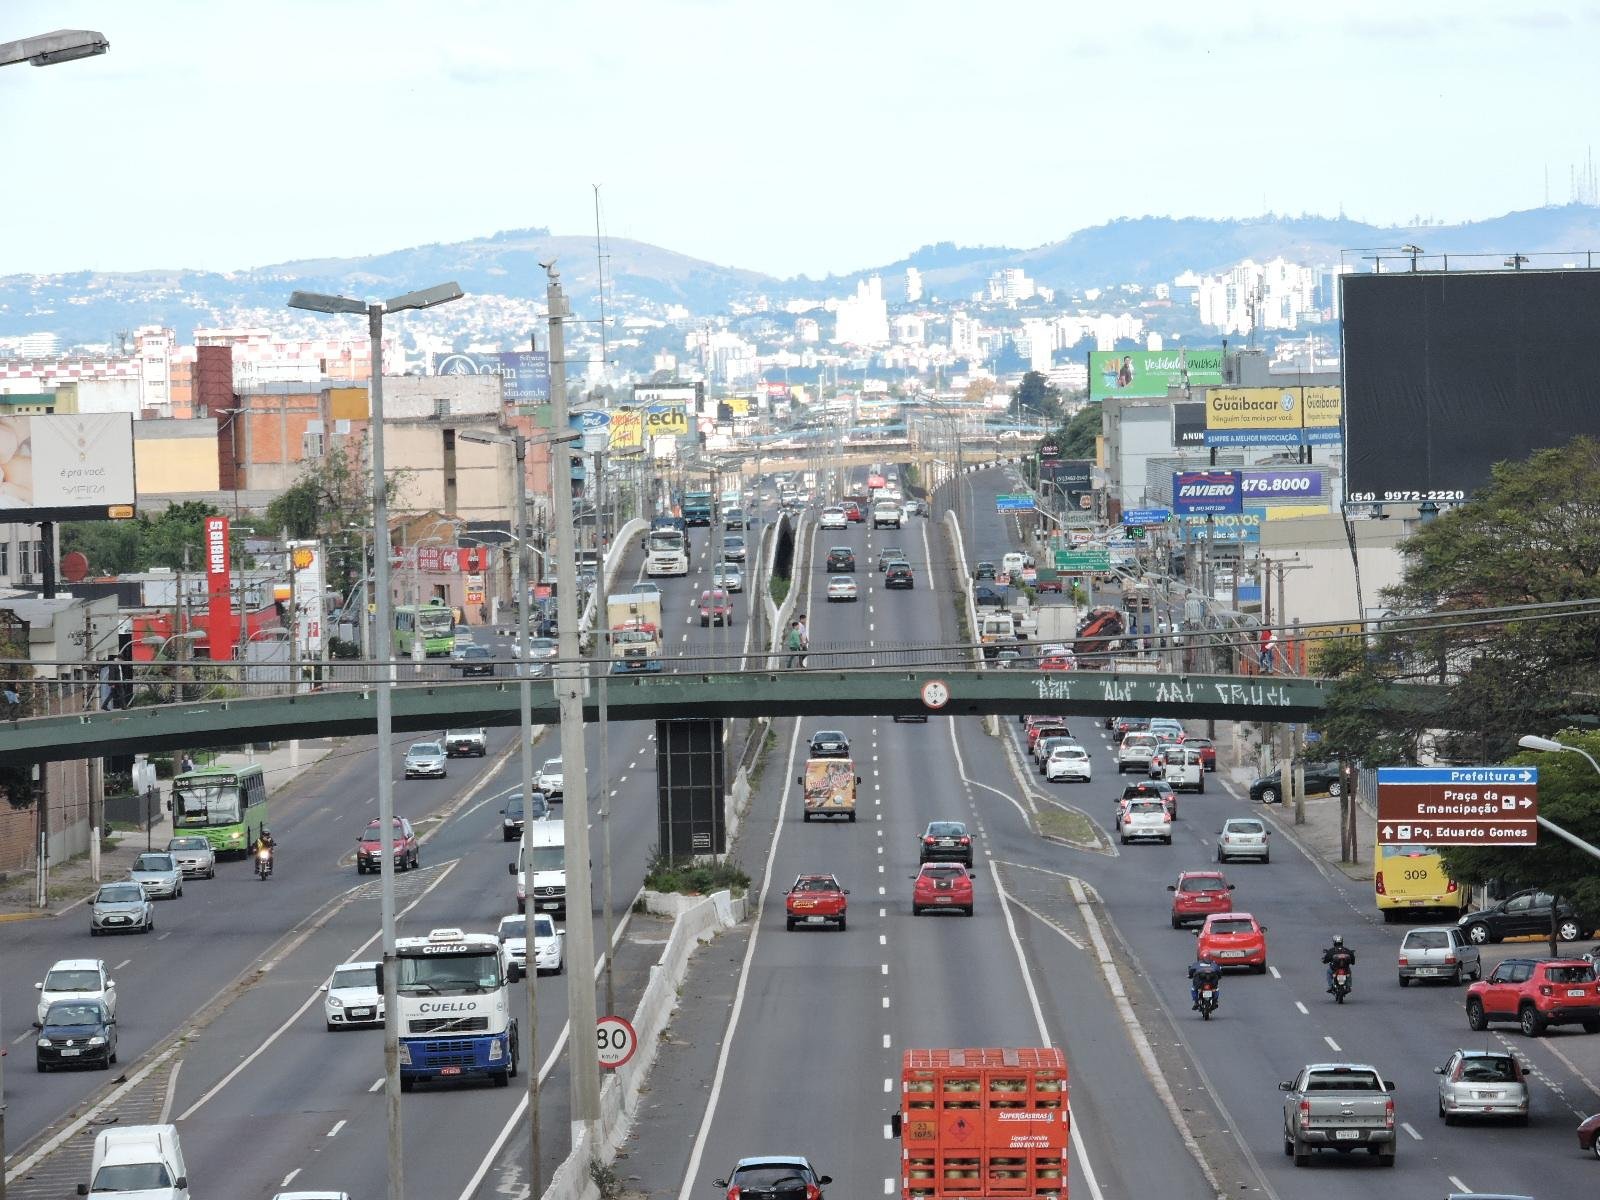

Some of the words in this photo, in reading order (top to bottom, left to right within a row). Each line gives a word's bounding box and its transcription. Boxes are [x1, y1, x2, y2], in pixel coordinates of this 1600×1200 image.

[480, 363, 517, 379] Odin
[1212, 395, 1279, 412] Guaibacar
[1212, 414, 1240, 423] Ninguém
[1240, 414, 1251, 423] faz
[1251, 414, 1266, 422] mais
[1266, 415, 1278, 424] por
[1208, 434, 1230, 443] SEMPRE
[1235, 434, 1259, 442] MELHOR
[1179, 484, 1235, 497] FAVIERO
[1350, 491, 1375, 501] (54)
[1384, 490, 1465, 500] 9972-2220
[208, 520, 225, 573] HABIB'S
[1451, 771, 1516, 781] Prefeitura
[1444, 790, 1478, 802] Praça
[1483, 790, 1498, 801] da
[1417, 803, 1499, 815] Emancipação
[1414, 827, 1433, 839] Pq.
[1436, 827, 1484, 837] Eduardo
[1489, 827, 1528, 837] Gomes
[1404, 869, 1428, 880] 309
[422, 945, 468, 954] CUELLO
[419, 1002, 477, 1013] CUELLO
[597, 1028, 627, 1049] 80
